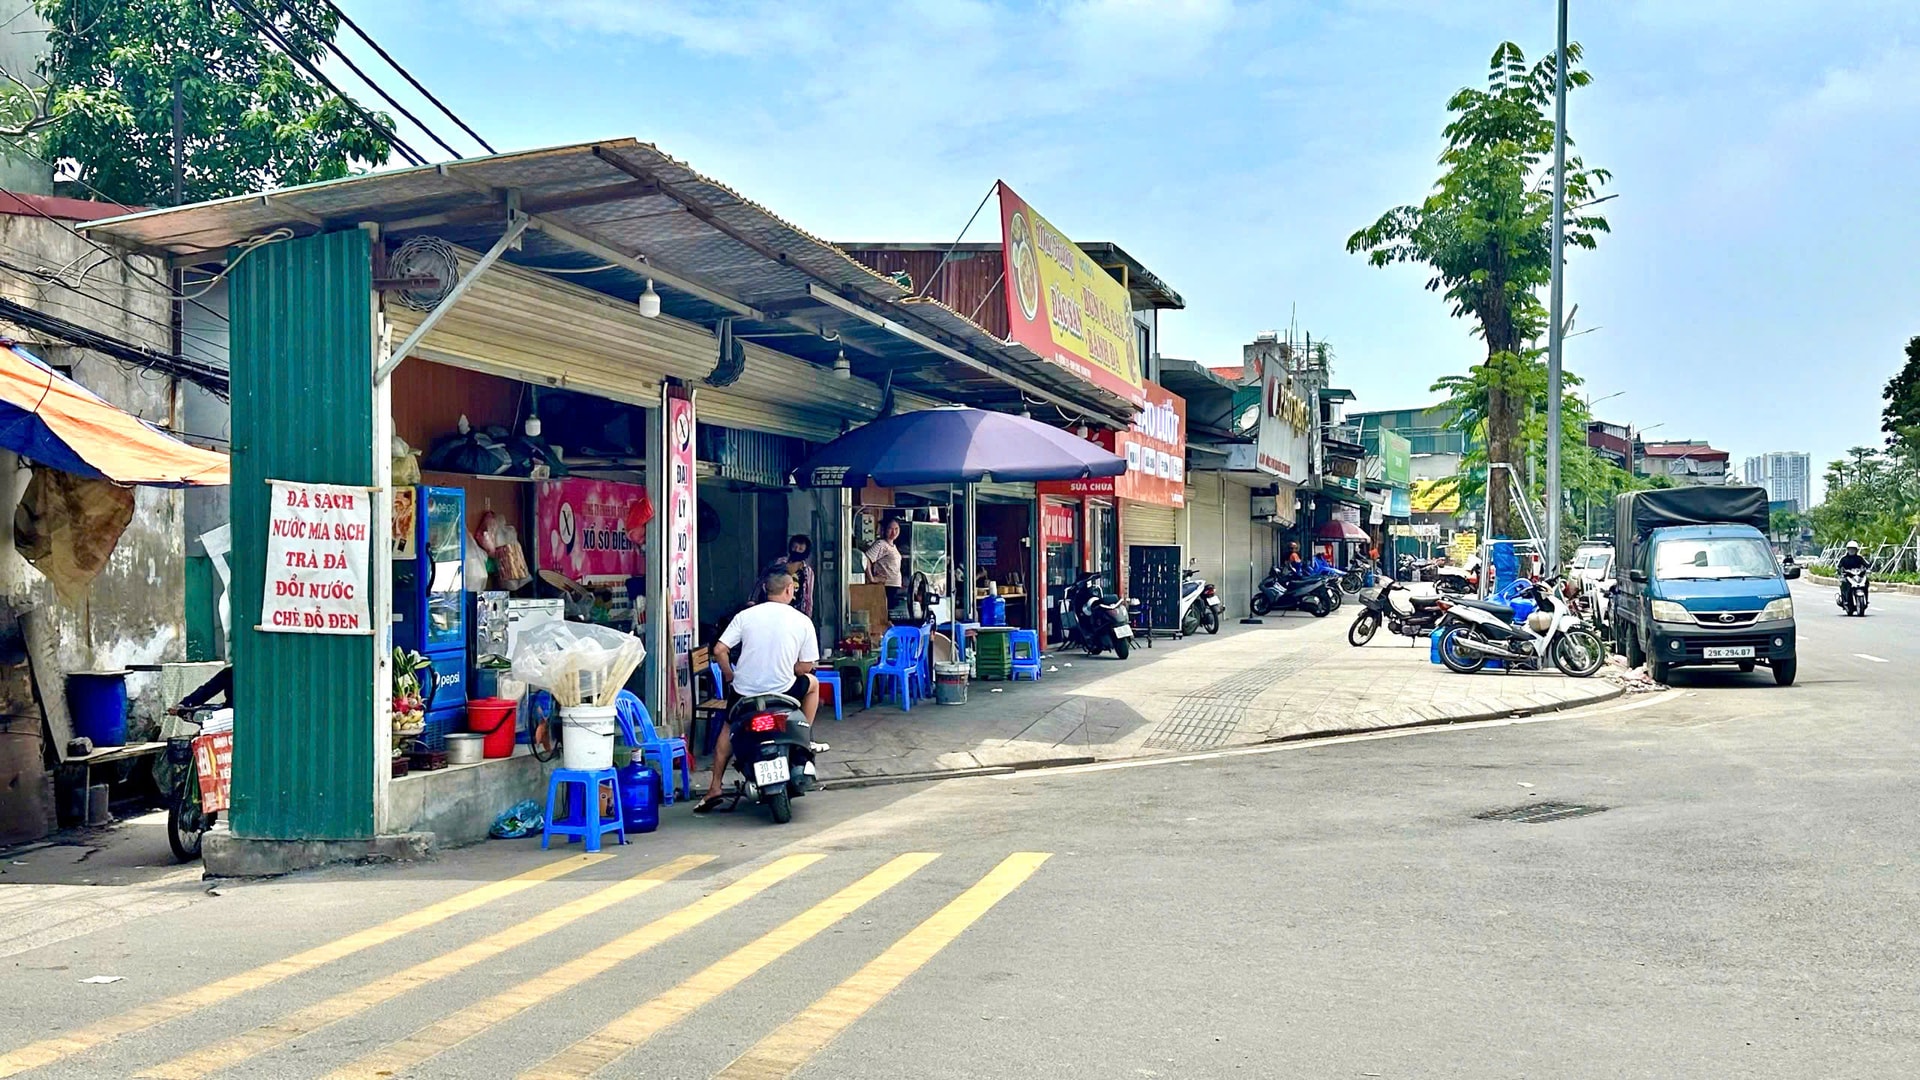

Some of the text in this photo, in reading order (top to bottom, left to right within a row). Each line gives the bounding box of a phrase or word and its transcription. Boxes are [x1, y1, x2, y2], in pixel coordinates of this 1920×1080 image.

[676, 464, 688, 488] ĐẠI
[314, 493, 354, 513] SẠCH
[678, 495, 686, 518] LÝ
[272, 516, 365, 545] NƯỚC MÍA SẠCH
[286, 549, 347, 569] TRÀ ĐÁ
[677, 562, 687, 586] SỐ
[276, 573, 354, 600] ĐỔI NƯỚC
[272, 606, 359, 629] CHÈ ĐỖ ĐEN
[673, 596, 690, 620] KIẾN
[440, 672, 460, 687] pepsi
